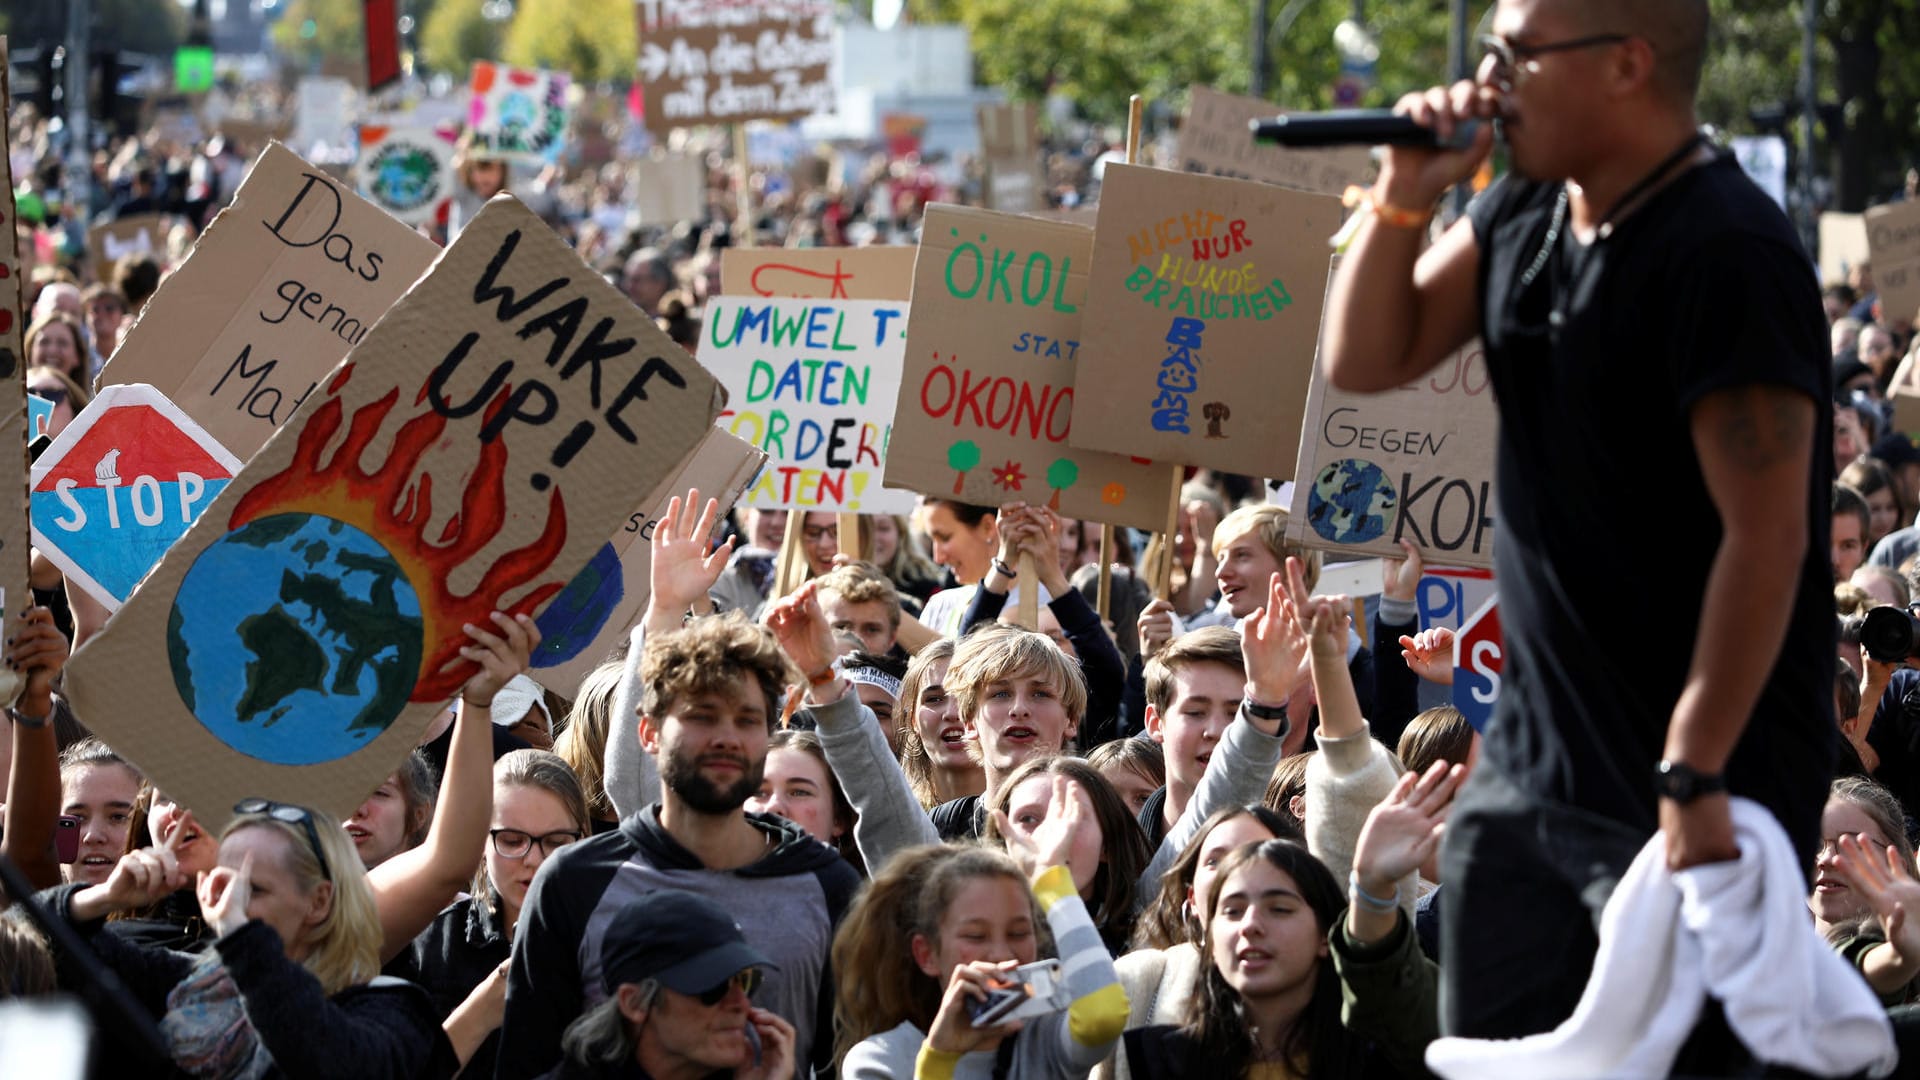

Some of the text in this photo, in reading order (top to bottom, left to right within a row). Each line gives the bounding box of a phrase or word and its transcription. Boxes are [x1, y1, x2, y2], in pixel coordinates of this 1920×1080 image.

[262, 173, 383, 281] Das
[1126, 210, 1224, 264] NICHT
[1192, 219, 1252, 261] NUR
[945, 227, 1088, 313] ÖKOL
[1125, 265, 1292, 320] BRAUCHEN
[1156, 253, 1260, 293] HUNDE
[474, 229, 686, 444] WAKE
[747, 359, 870, 405] DATEN
[428, 332, 595, 491] UP!
[721, 409, 891, 469] ORDER
[54, 471, 205, 532] STOP
[747, 466, 869, 510] ATEN!
